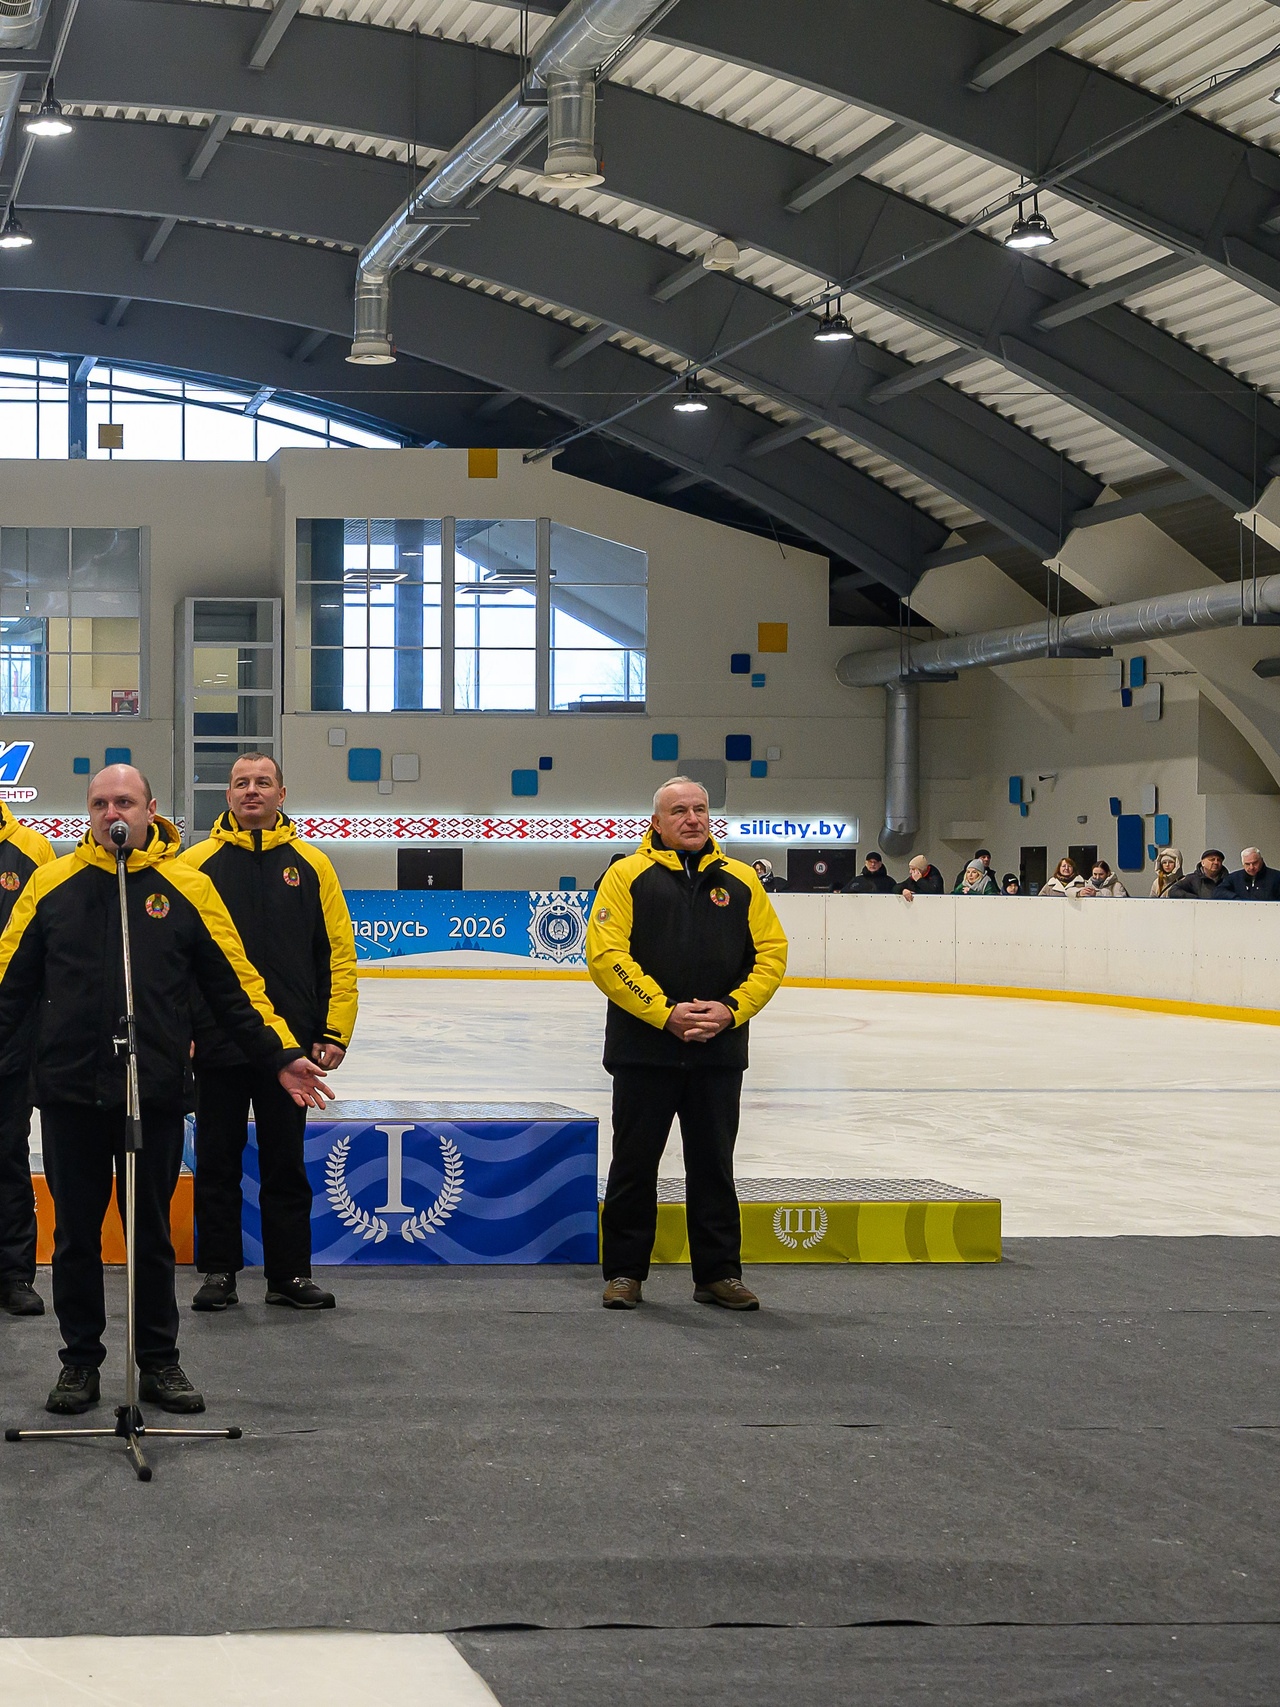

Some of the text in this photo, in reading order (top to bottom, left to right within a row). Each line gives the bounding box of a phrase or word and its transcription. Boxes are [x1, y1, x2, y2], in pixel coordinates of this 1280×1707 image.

[740, 820, 847, 839] silichy.by
[448, 916, 507, 939] 2026
[612, 963, 653, 1005] BELARUS
[782, 1208, 819, 1233] III
